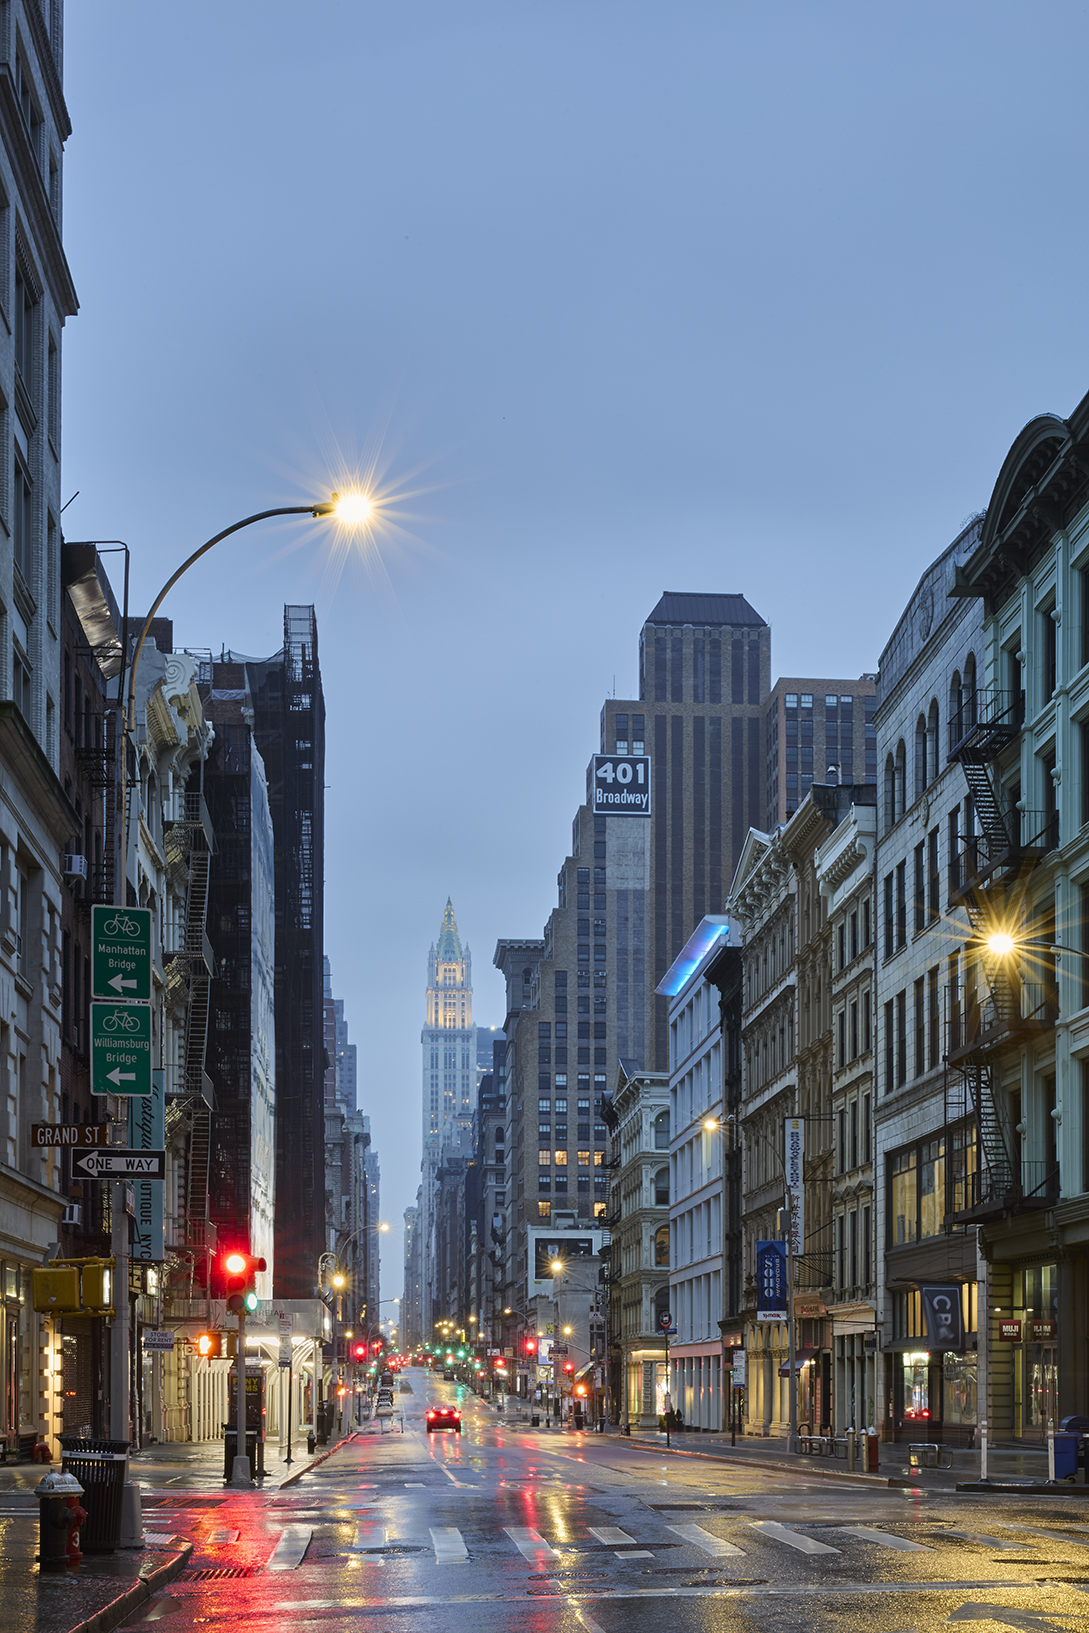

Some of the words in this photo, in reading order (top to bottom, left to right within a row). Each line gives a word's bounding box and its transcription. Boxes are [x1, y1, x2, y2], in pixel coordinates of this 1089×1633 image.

[596, 762, 644, 784] 401
[596, 788, 648, 808] Broadway
[98, 944, 146, 956] Manhattan
[108, 959, 136, 971] Bridge
[94, 1038, 149, 1051] Williamsburg
[106, 1053, 137, 1065] Bridge
[37, 1127, 79, 1145] GRAND
[85, 1126, 100, 1143] ST
[86, 1158, 113, 1170] ONE
[125, 1159, 154, 1171] WAY
[140, 1180, 152, 1225] UTIQUE
[140, 1234, 152, 1258] NYC
[232, 1377, 258, 1385] FNY
[72, 1531, 80, 1548] 3
